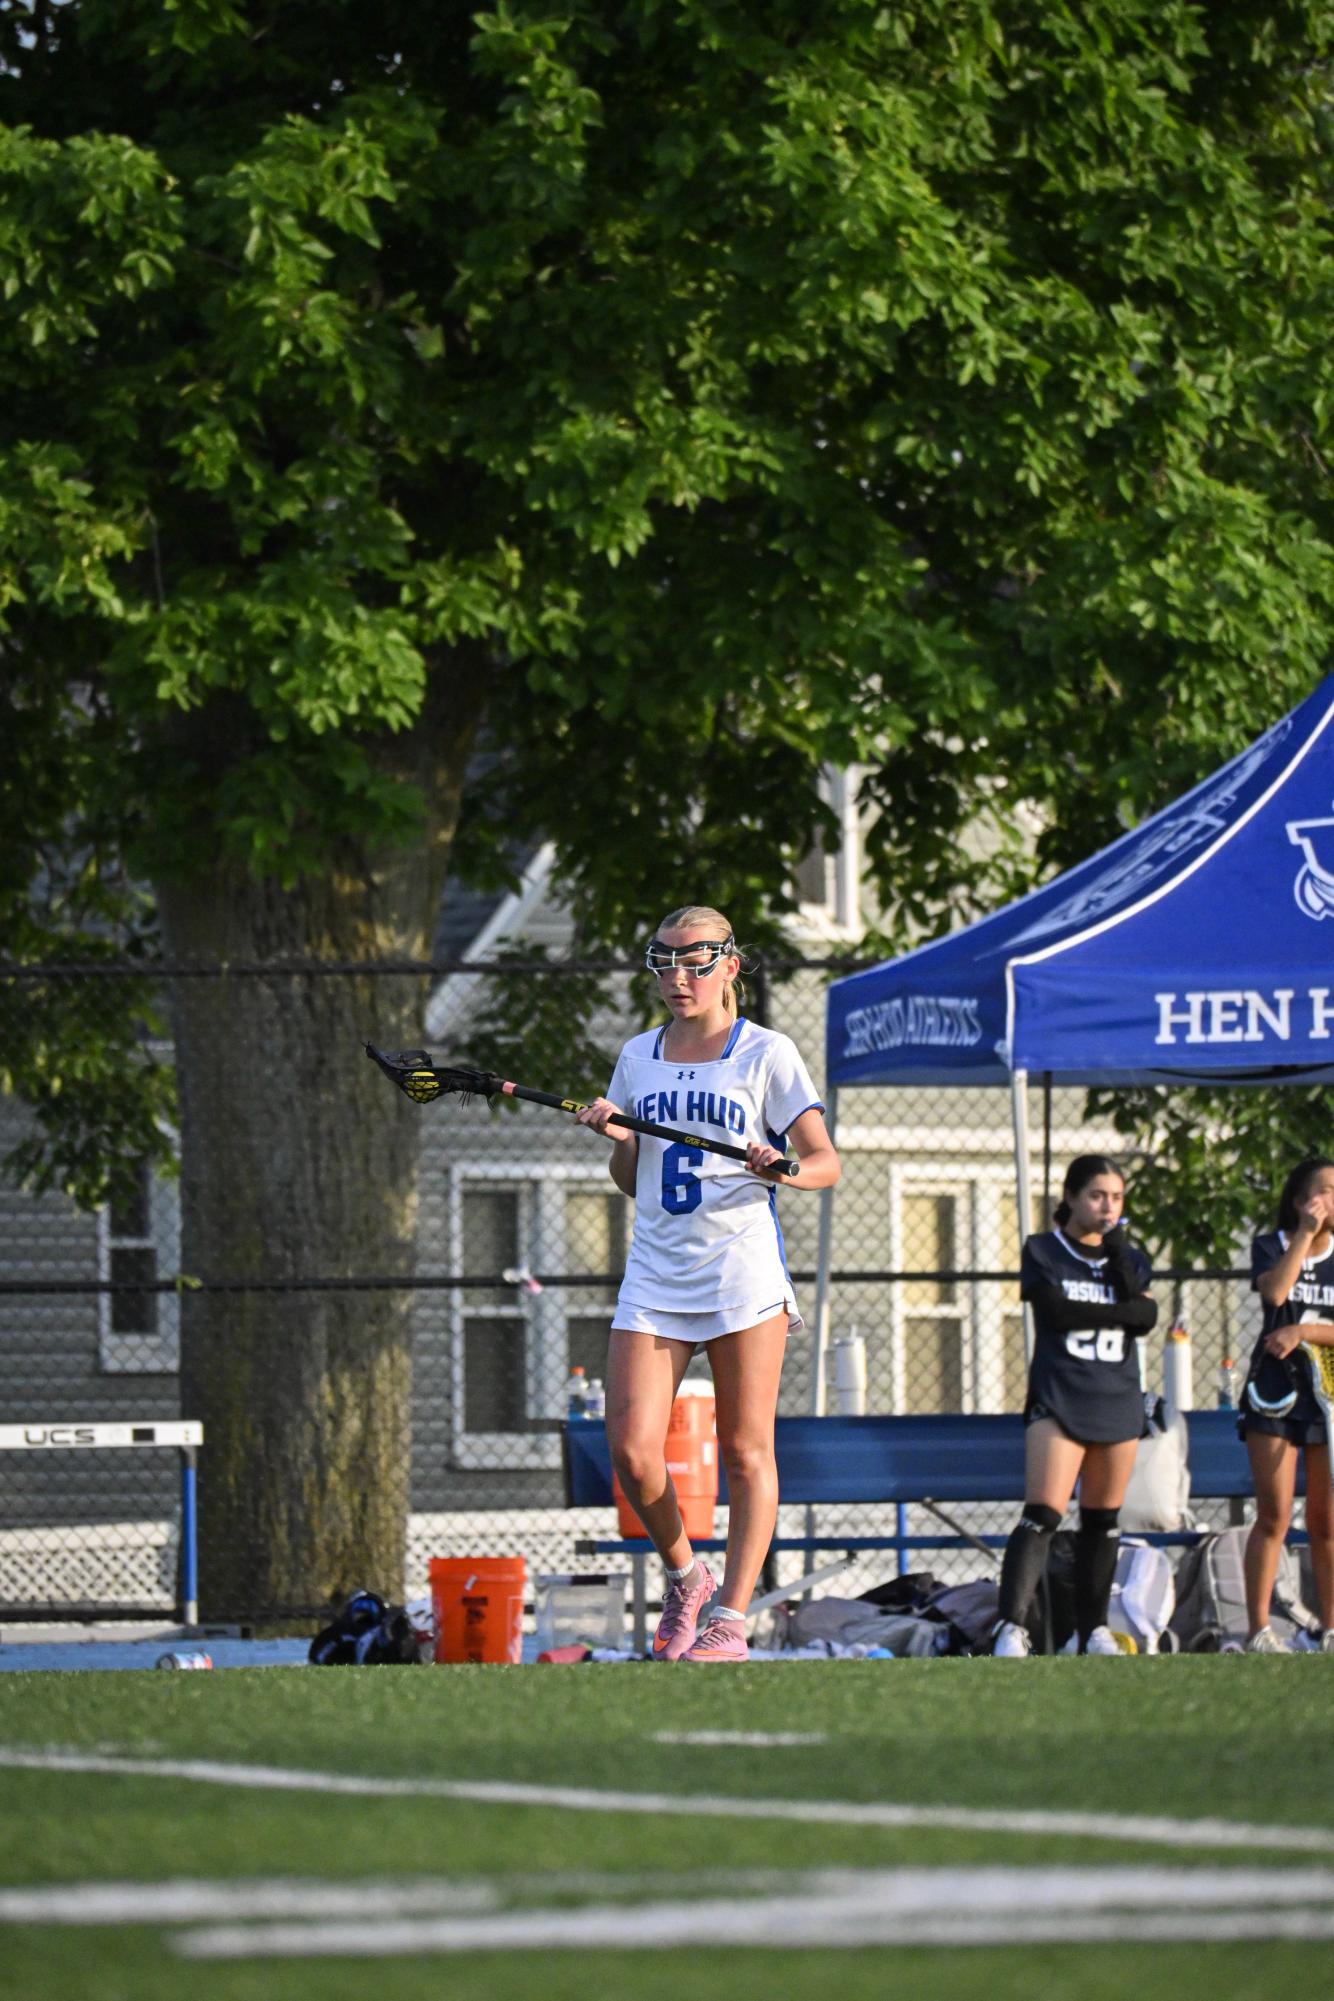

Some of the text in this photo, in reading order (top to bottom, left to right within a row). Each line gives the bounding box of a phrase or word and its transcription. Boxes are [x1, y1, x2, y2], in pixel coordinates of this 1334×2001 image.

[1155, 989, 1294, 1045] HEN
[687, 1091, 746, 1136] HUD
[661, 1142, 704, 1216] 6
[25, 1428, 95, 1445] UCS
